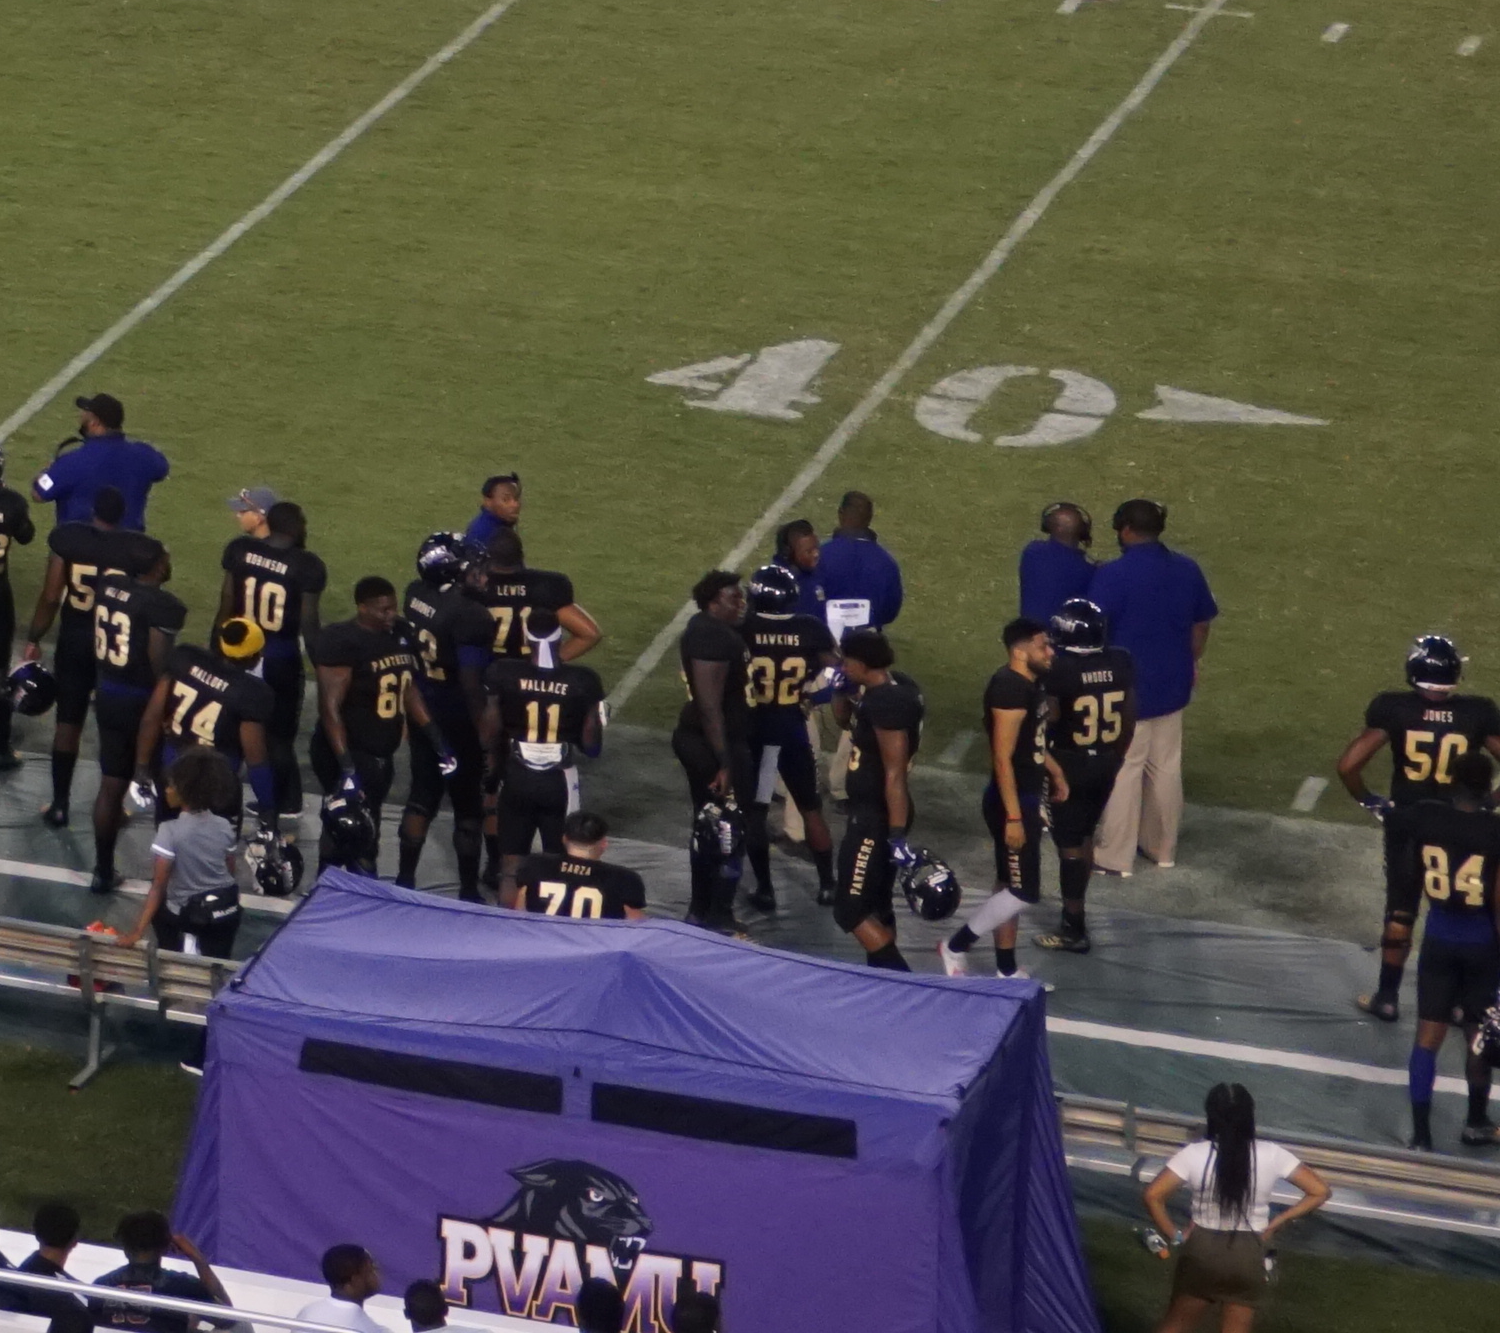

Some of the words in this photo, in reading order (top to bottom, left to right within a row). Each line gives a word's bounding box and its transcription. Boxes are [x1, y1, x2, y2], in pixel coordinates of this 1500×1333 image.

[243, 576, 287, 633] 10
[496, 584, 527, 597] LEWIS
[93, 604, 132, 668] 63
[492, 605, 533, 655] 71
[754, 632, 800, 648] HAWKINS
[519, 676, 569, 696] WALLACE
[171, 681, 223, 744] 74
[525, 700, 561, 744] 11
[1072, 690, 1126, 747] 35
[1422, 709, 1455, 725] JONES
[1403, 730, 1468, 785] 50
[849, 837, 876, 897] PANTHERS
[1421, 844, 1486, 907] 84
[537, 881, 604, 919] 70
